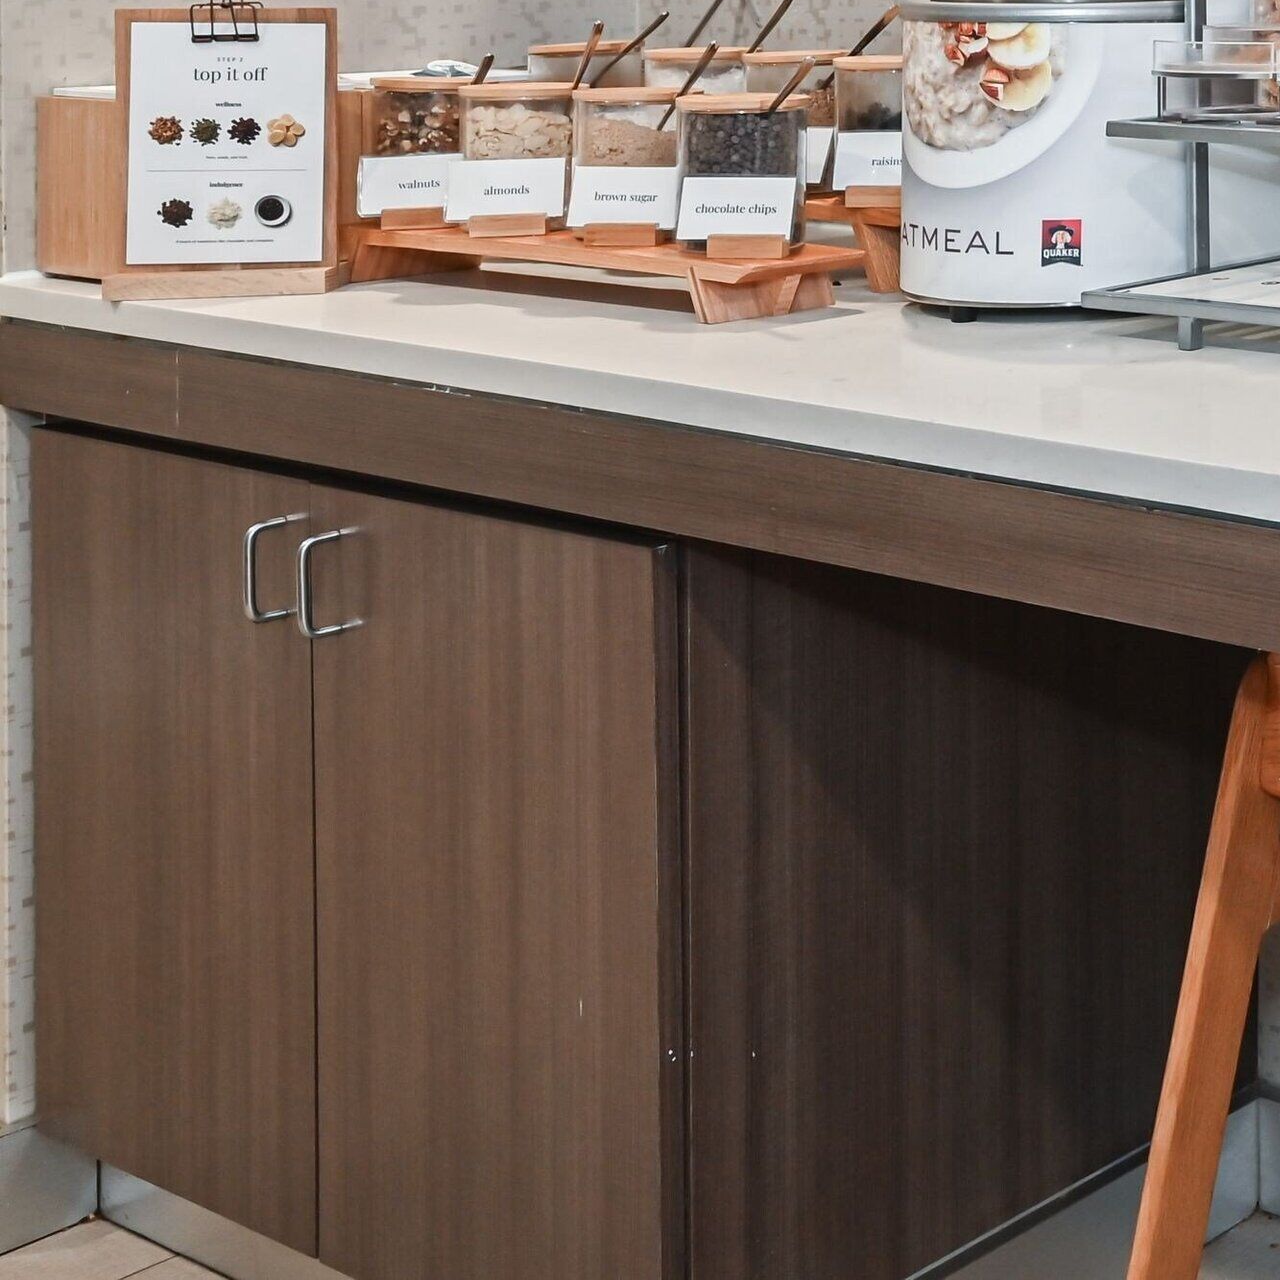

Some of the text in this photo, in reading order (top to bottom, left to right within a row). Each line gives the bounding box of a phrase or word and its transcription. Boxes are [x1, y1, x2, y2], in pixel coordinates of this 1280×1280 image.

[193, 66, 269, 84] top it off
[398, 179, 441, 190] walnuts
[483, 184, 530, 196] almonds
[594, 191, 658, 204] brown sugar
[695, 203, 777, 216] chocolate chips
[1043, 248, 1080, 259] QUAKER
